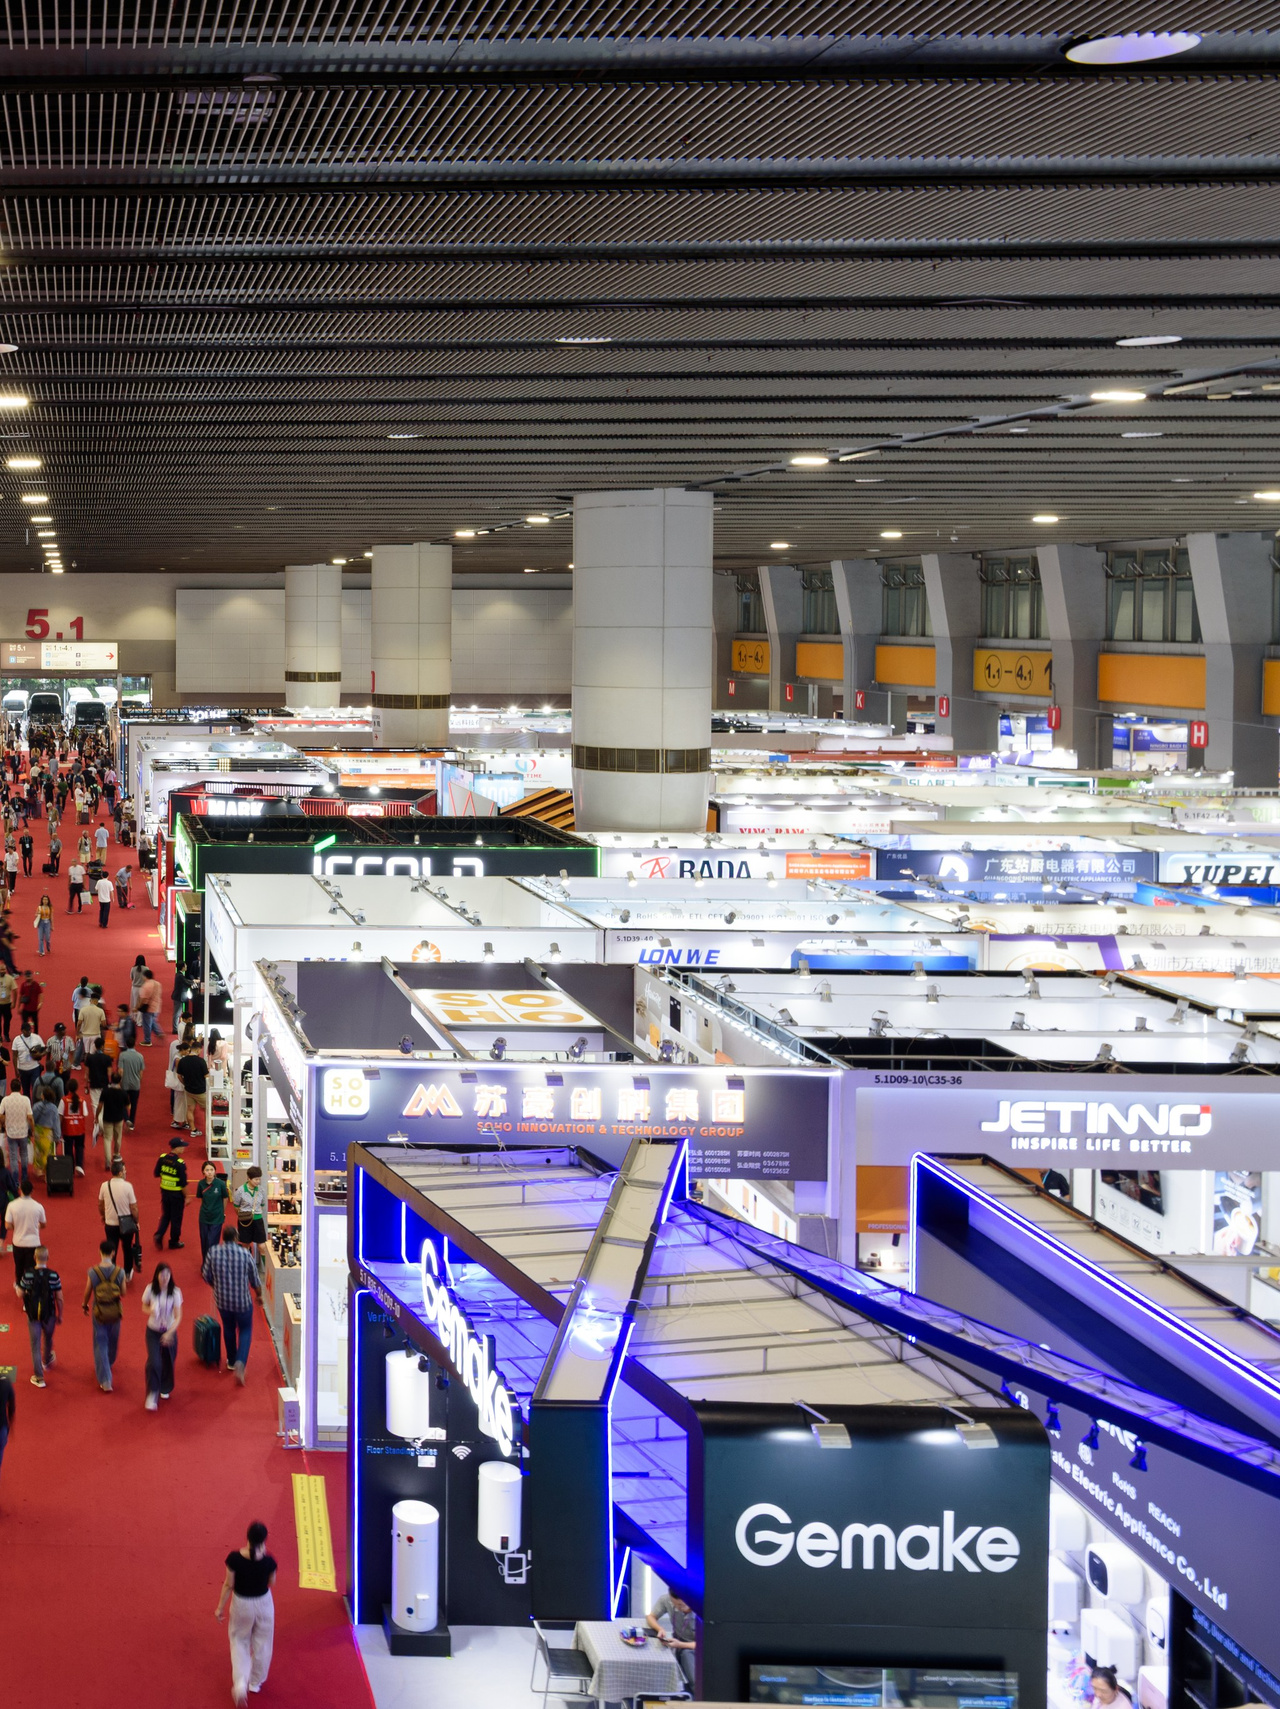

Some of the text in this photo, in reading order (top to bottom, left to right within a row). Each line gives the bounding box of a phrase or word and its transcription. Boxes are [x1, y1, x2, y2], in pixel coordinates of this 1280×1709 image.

[25, 608, 84, 640] 5.1
[728, 681, 735, 695] M
[786, 686, 792, 700] L
[857, 693, 864, 708] K
[941, 698, 947, 716] J
[1193, 724, 1205, 745] H
[874, 1075, 963, 1086] 5.1D09-10\C35-36
[473, 1084, 746, 1123] 苏豪创科集团
[980, 1100, 1212, 1137] JETINNO
[477, 1121, 745, 1138] SOHO INNOVATION & TECHNOLOGY GROUP
[1011, 1137, 1192, 1153] INSPIRE LIFE BETTER
[421, 1238, 514, 1457] Gemake
[366, 1445, 384, 1454] Floor
[385, 1446, 415, 1457] Standing
[1112, 1470, 1137, 1501] RoHS
[1148, 1502, 1182, 1538] REACH
[735, 1502, 1020, 1573] Gemake
[1071, 1462, 1115, 1514] Electric
[1114, 1501, 1175, 1567] Appliance
[1203, 1577, 1228, 1611] Ltd
